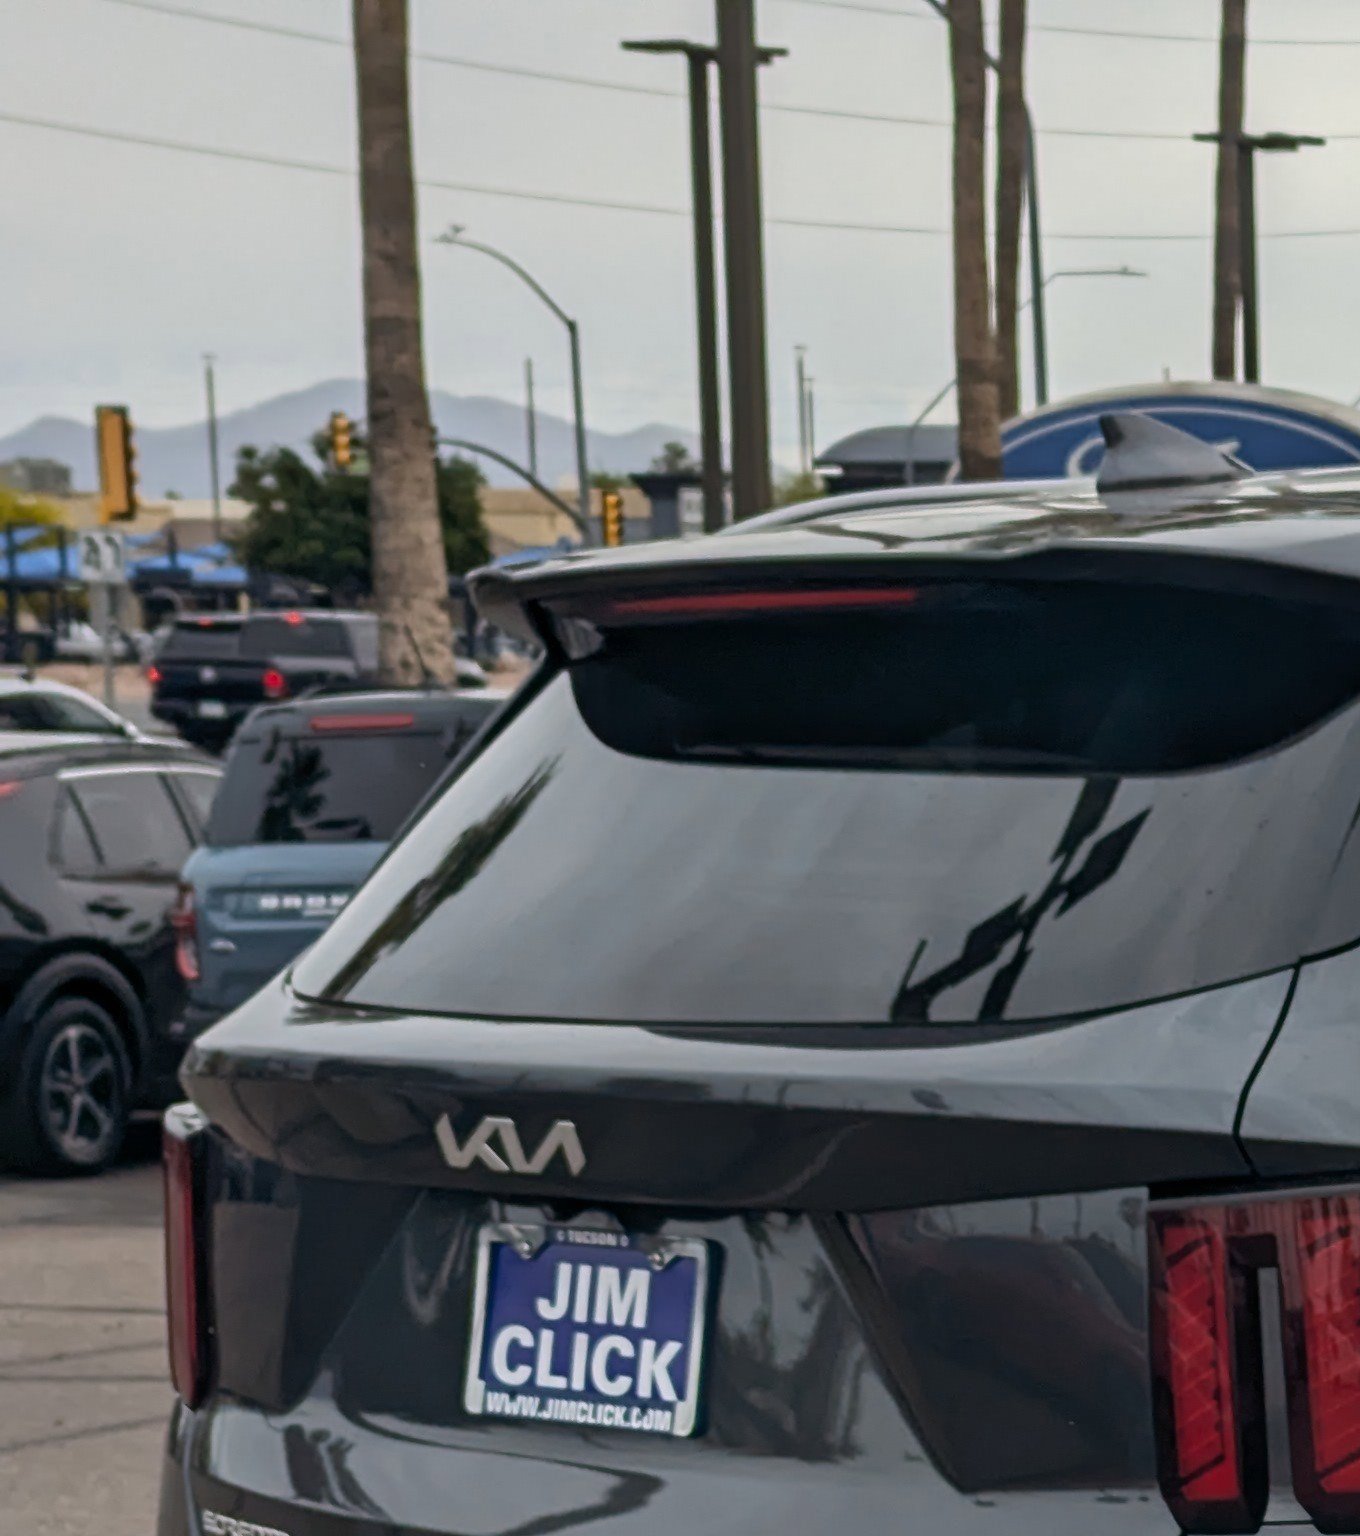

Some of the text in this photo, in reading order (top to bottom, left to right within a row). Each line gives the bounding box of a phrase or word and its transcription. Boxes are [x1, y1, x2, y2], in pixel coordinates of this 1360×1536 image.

[435, 1113, 587, 1178] KIA
[535, 1262, 652, 1329] JIM
[490, 1324, 684, 1403] CLICK
[486, 1390, 673, 1432] WWW.JIMCLICK.COM
